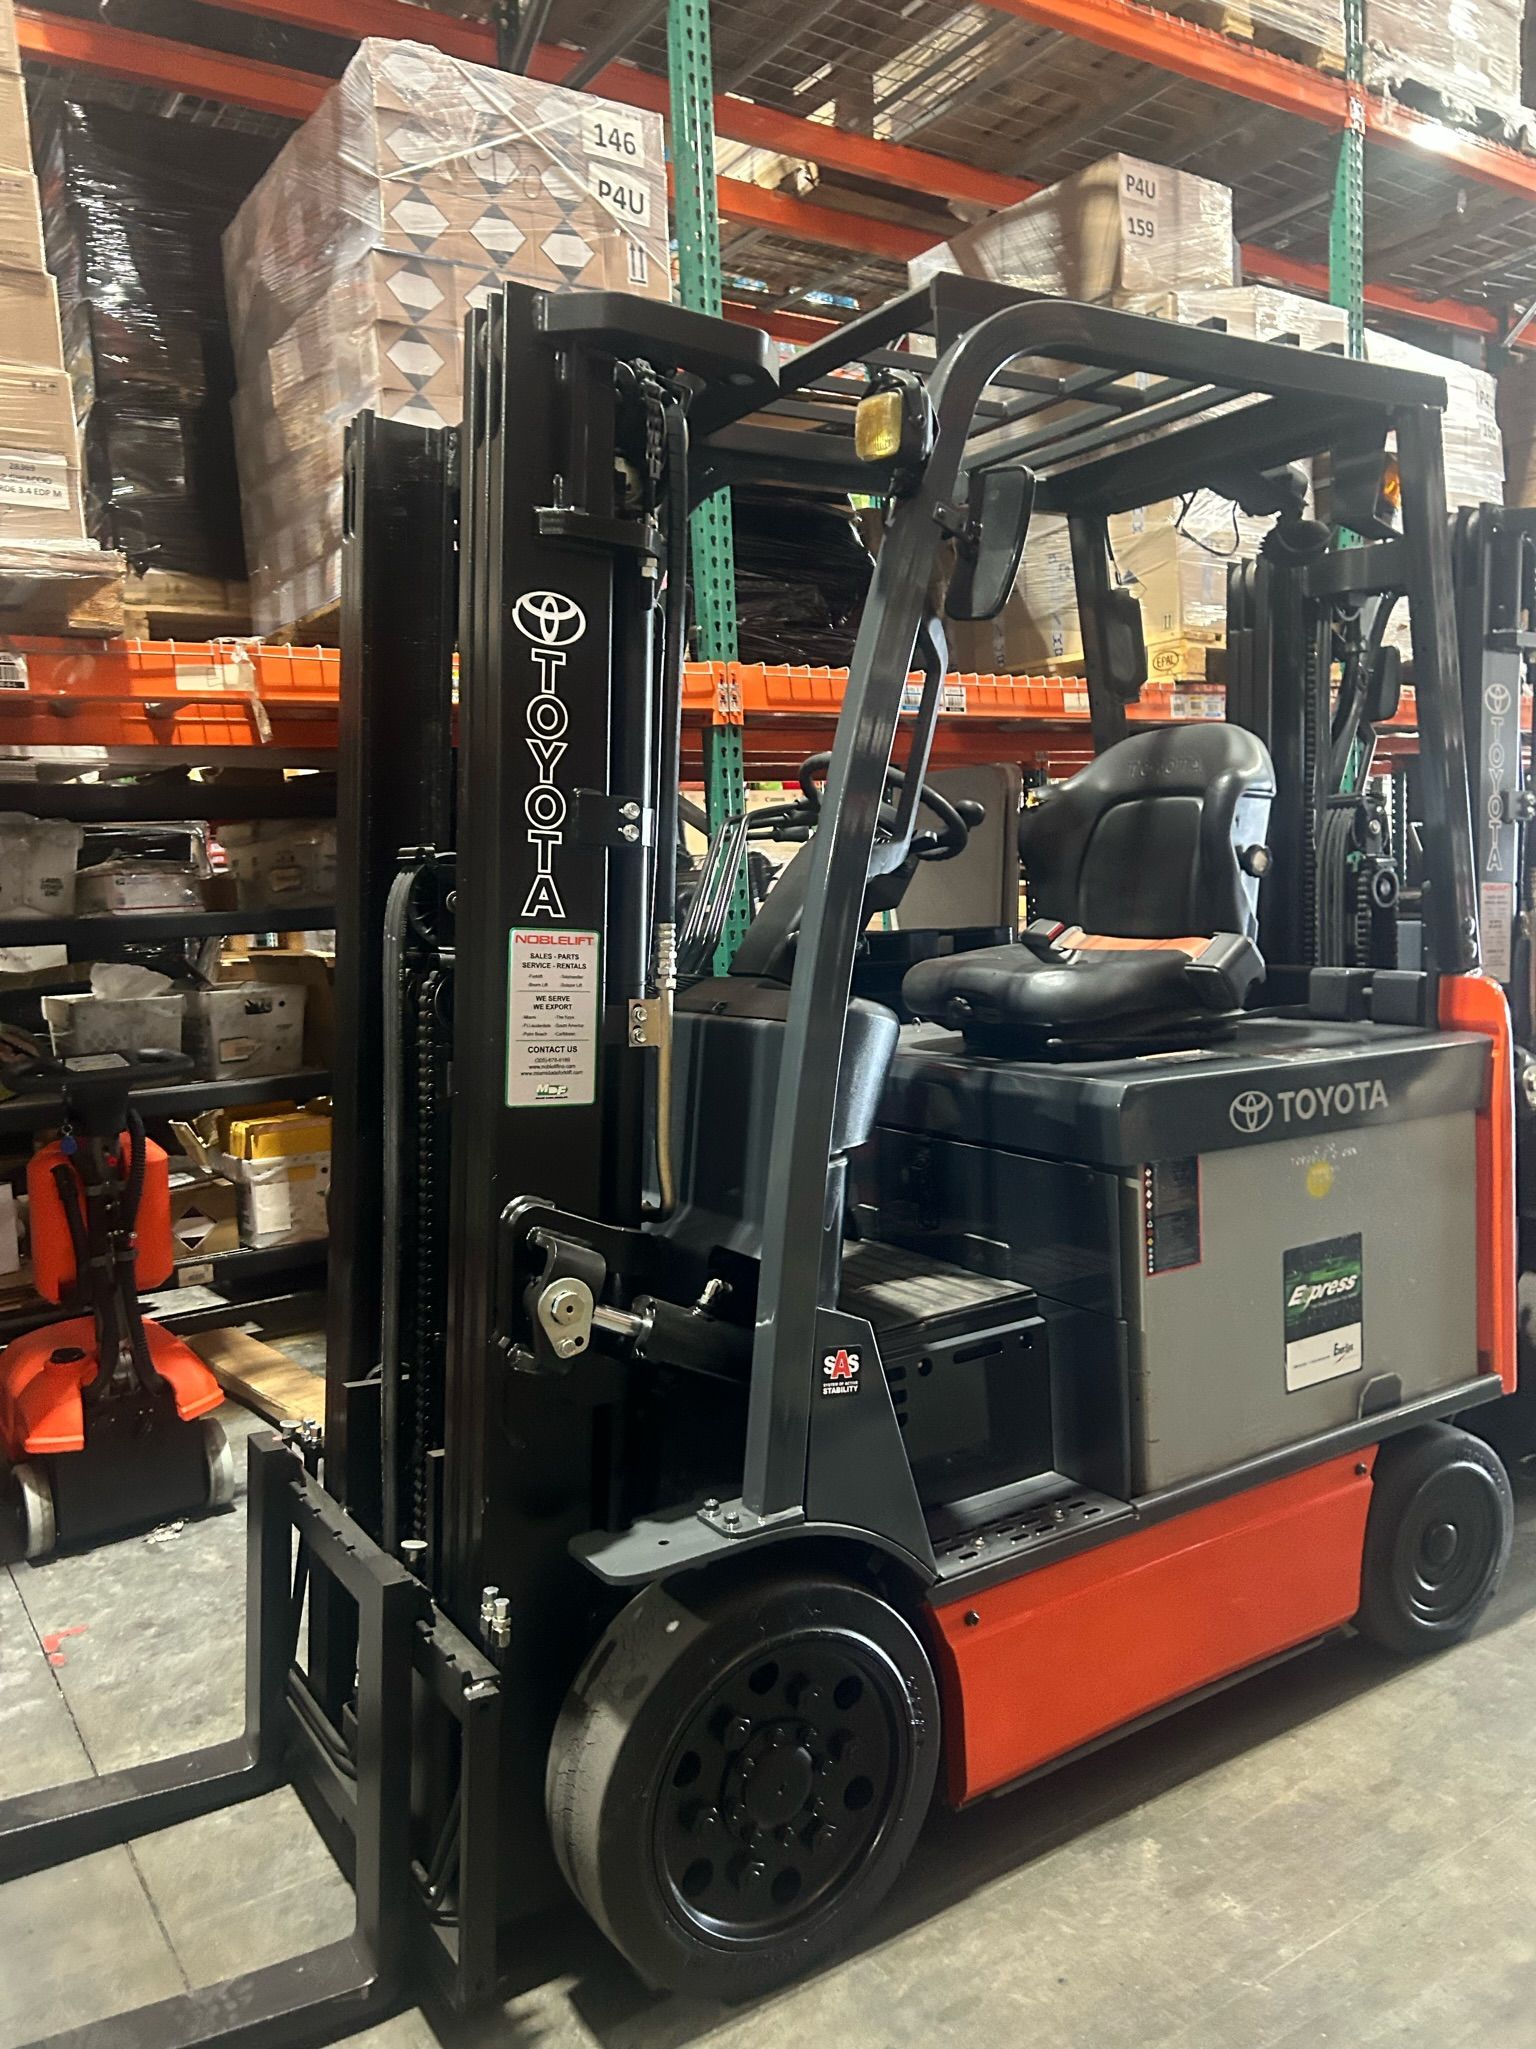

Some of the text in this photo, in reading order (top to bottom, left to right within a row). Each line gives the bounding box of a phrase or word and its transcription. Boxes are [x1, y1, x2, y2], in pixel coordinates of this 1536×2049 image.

[593, 122, 636, 155] 146
[598, 179, 644, 215] P4U
[1126, 174, 1156, 199] P4U
[1128, 216, 1154, 239] 159
[1156, 654, 1174, 668] EPAL
[520, 647, 569, 919] TOYOTA
[1486, 716, 1505, 871] TOYOTA
[515, 934, 594, 946] NOBLELIFT
[530, 952, 553, 960] SALES
[528, 1045, 578, 1053] CONTACT US
[1277, 1079, 1389, 1123] TOYOTA
[823, 1349, 860, 1380] SAS
[823, 1385, 858, 1395] STABILITY
